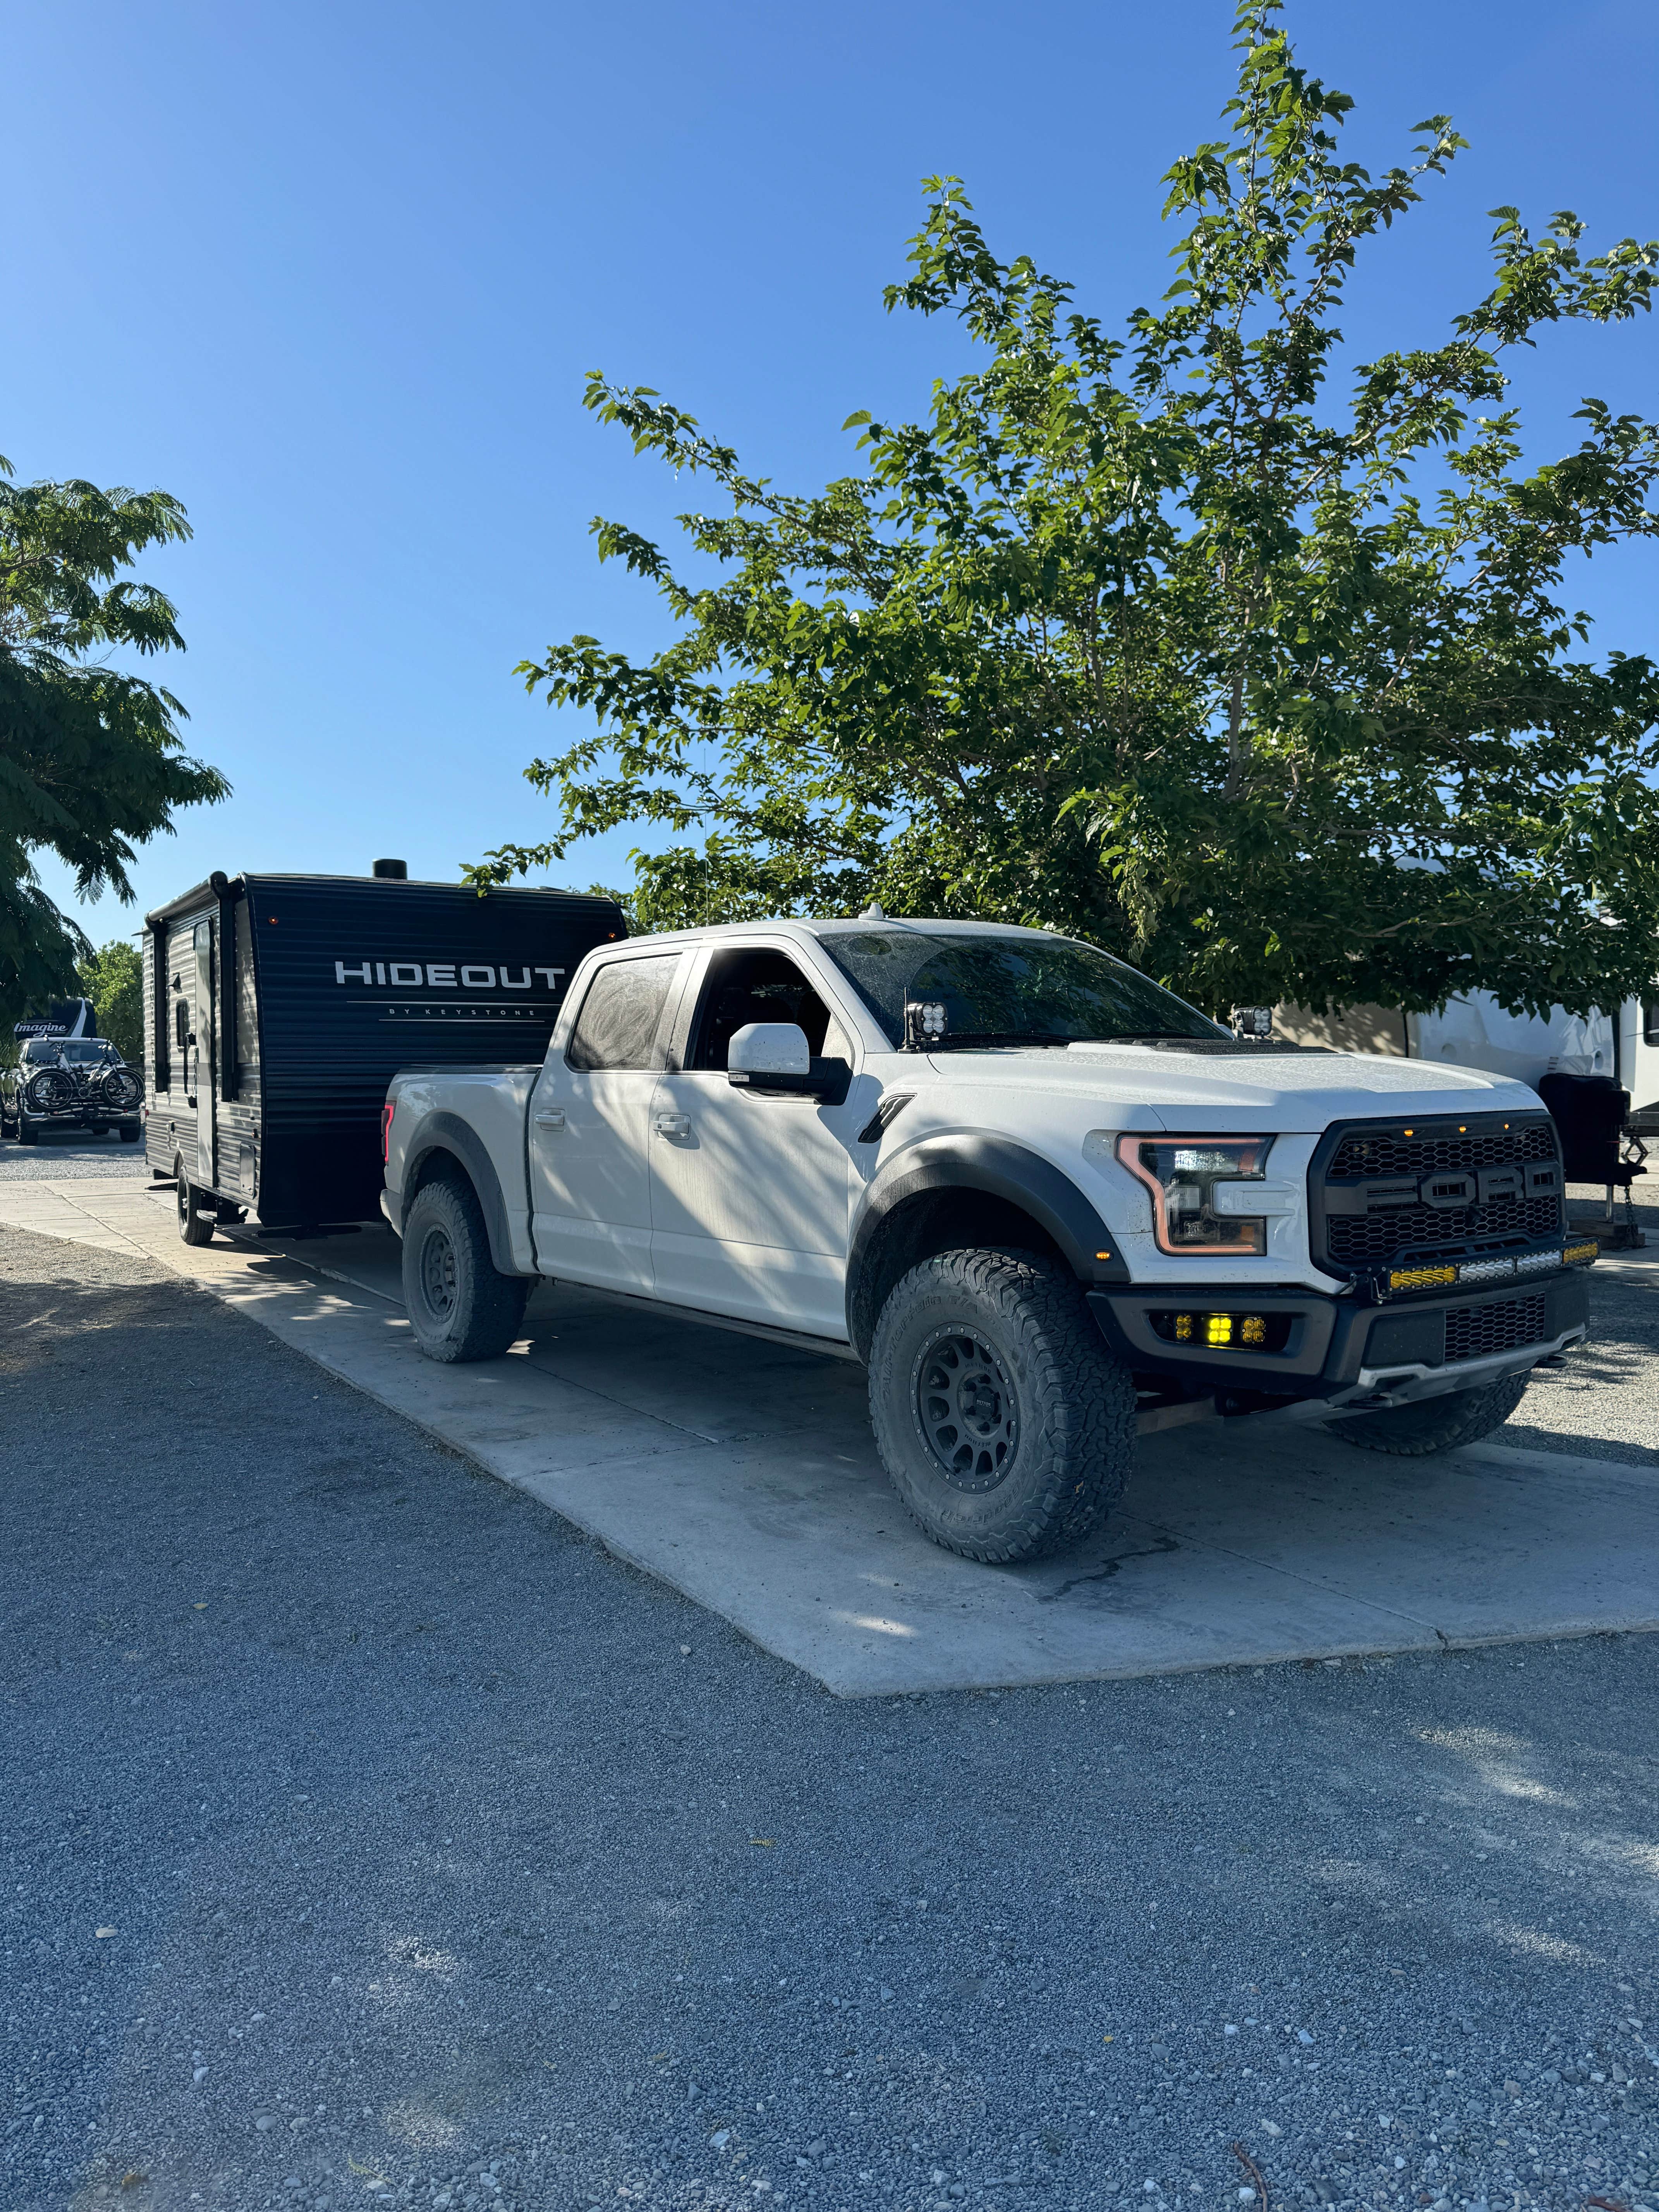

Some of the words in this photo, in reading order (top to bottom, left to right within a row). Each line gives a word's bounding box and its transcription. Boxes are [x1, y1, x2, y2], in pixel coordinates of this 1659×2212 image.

[335, 961, 565, 989] HIDEOUT
[14, 1022, 68, 1037] Imagine
[1326, 1163, 1561, 1215] FORD
